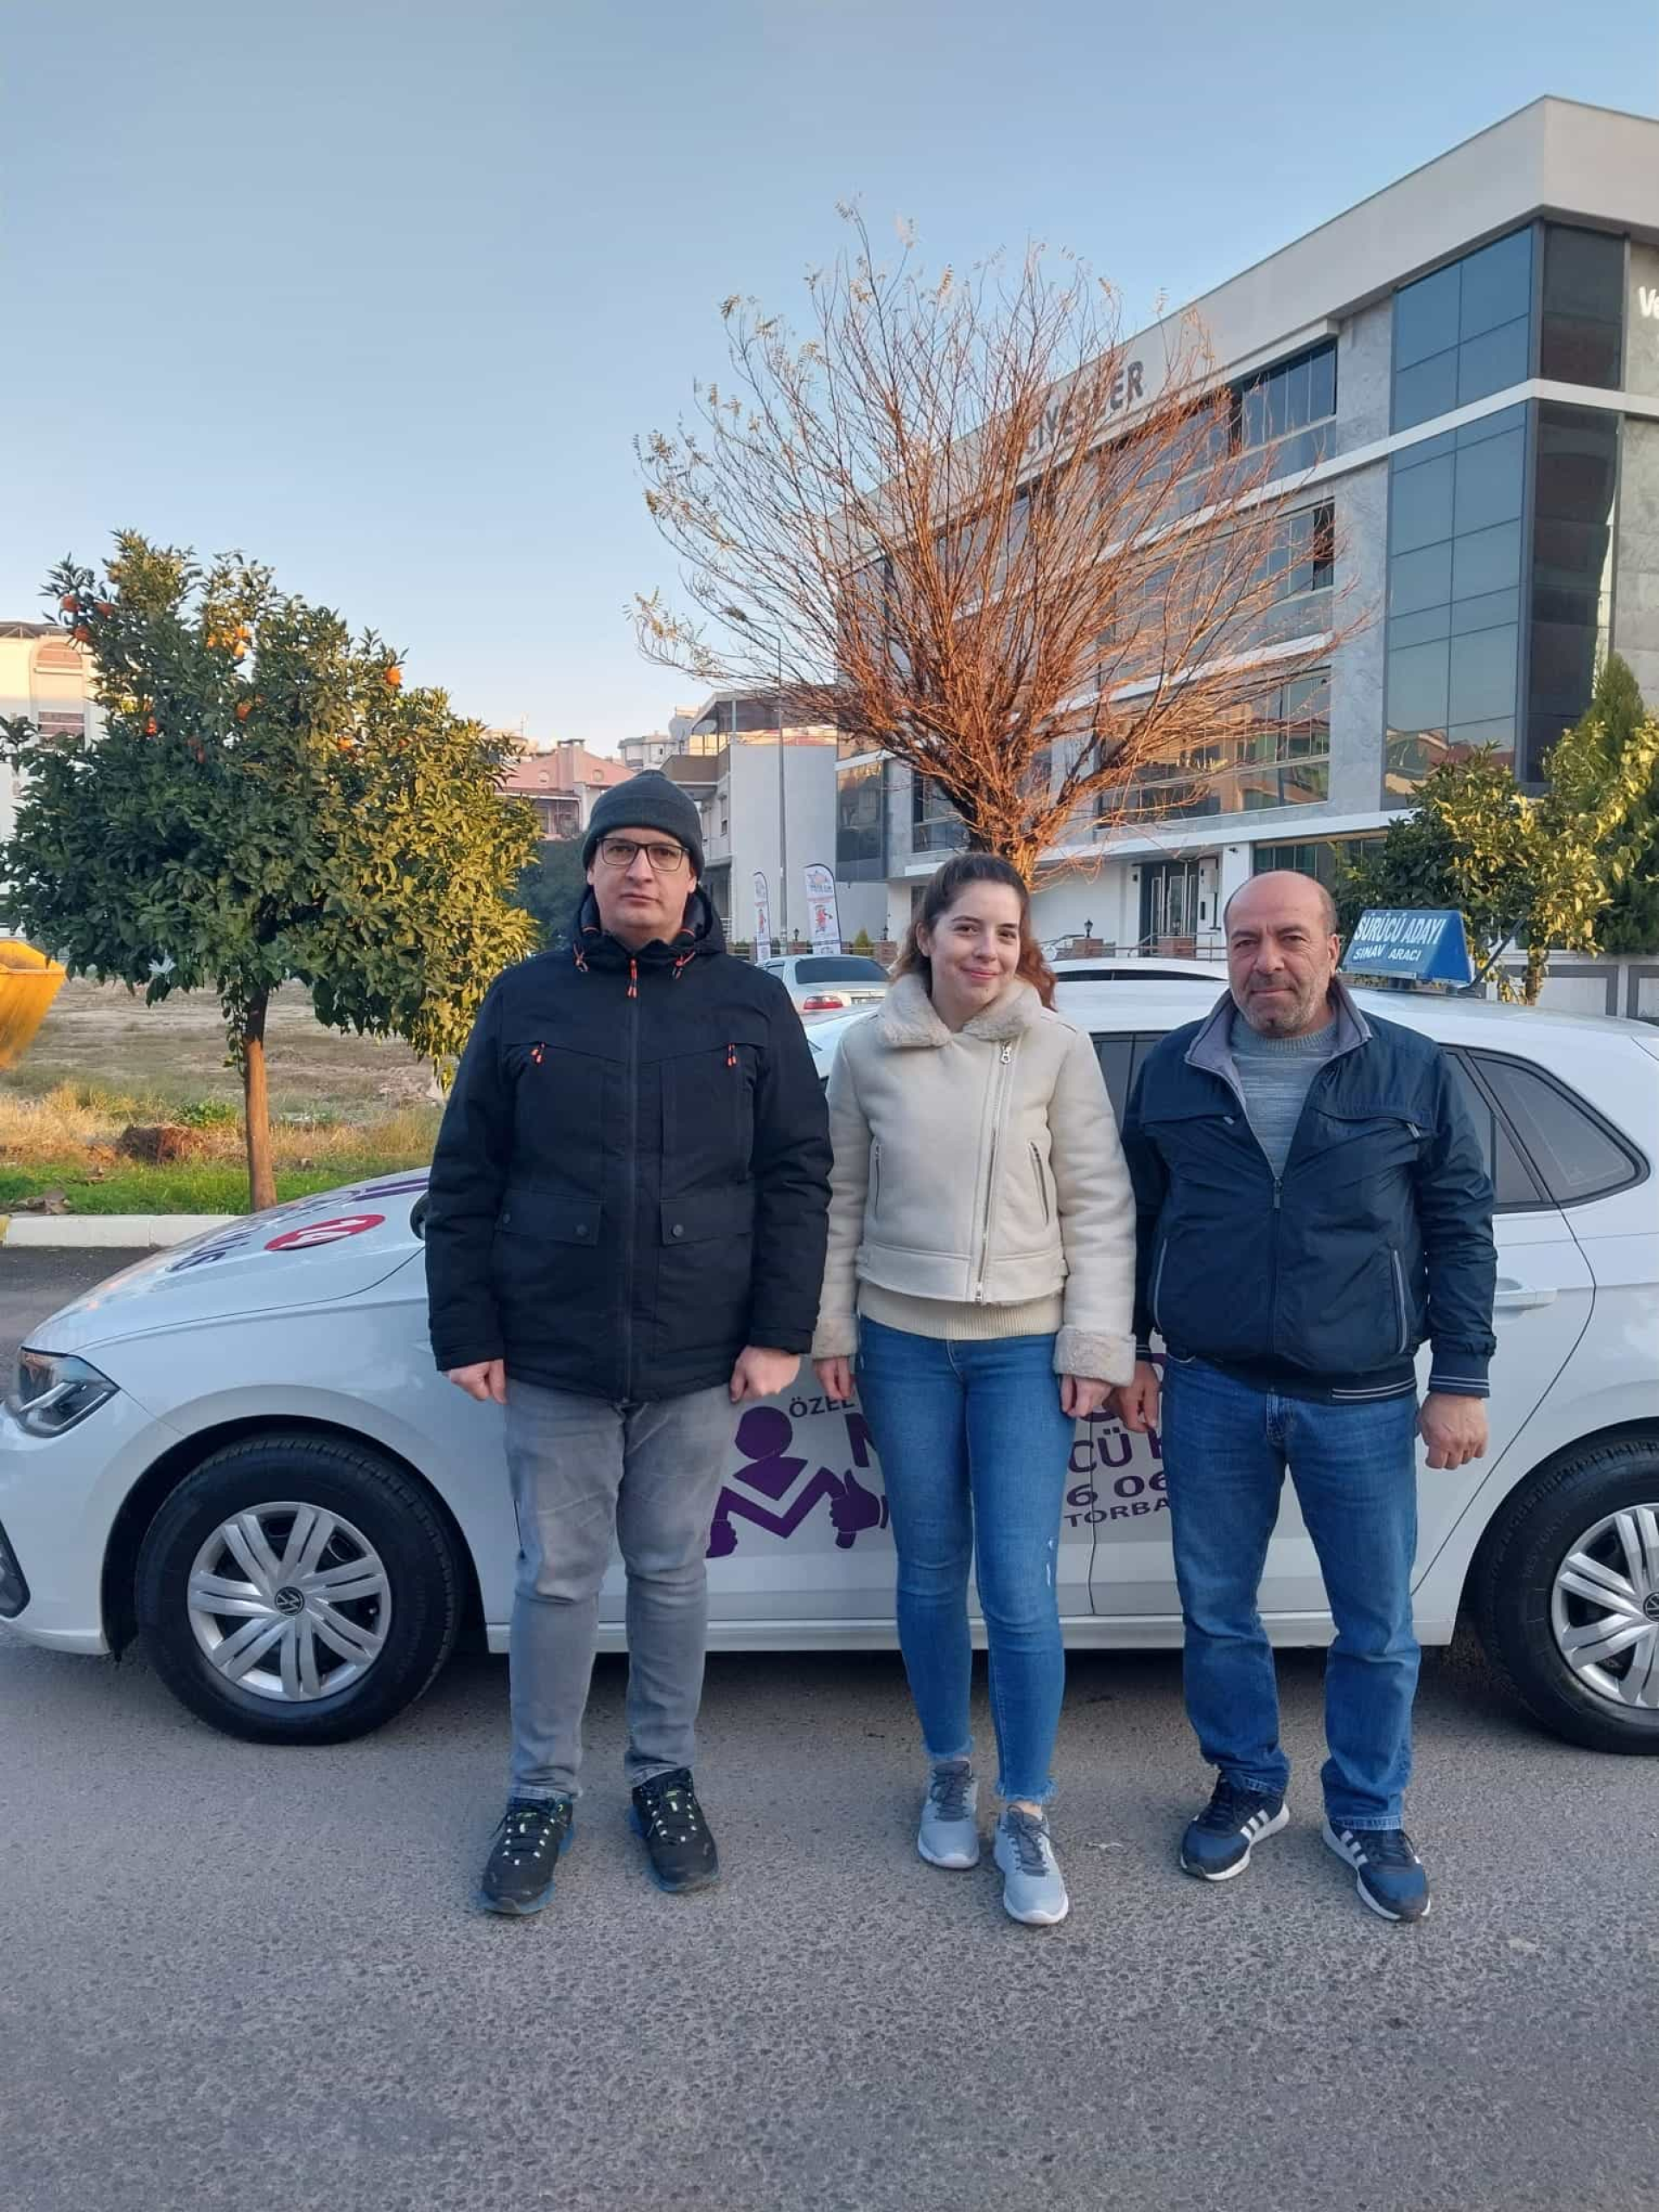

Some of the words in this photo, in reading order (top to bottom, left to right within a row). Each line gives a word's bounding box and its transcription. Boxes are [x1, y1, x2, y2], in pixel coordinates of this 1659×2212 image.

[1353, 912, 1408, 941] SÜRÜCÜ
[1402, 918, 1447, 945] ADAYI
[1352, 944, 1386, 961] SINAV
[1388, 949, 1423, 962] ARACI
